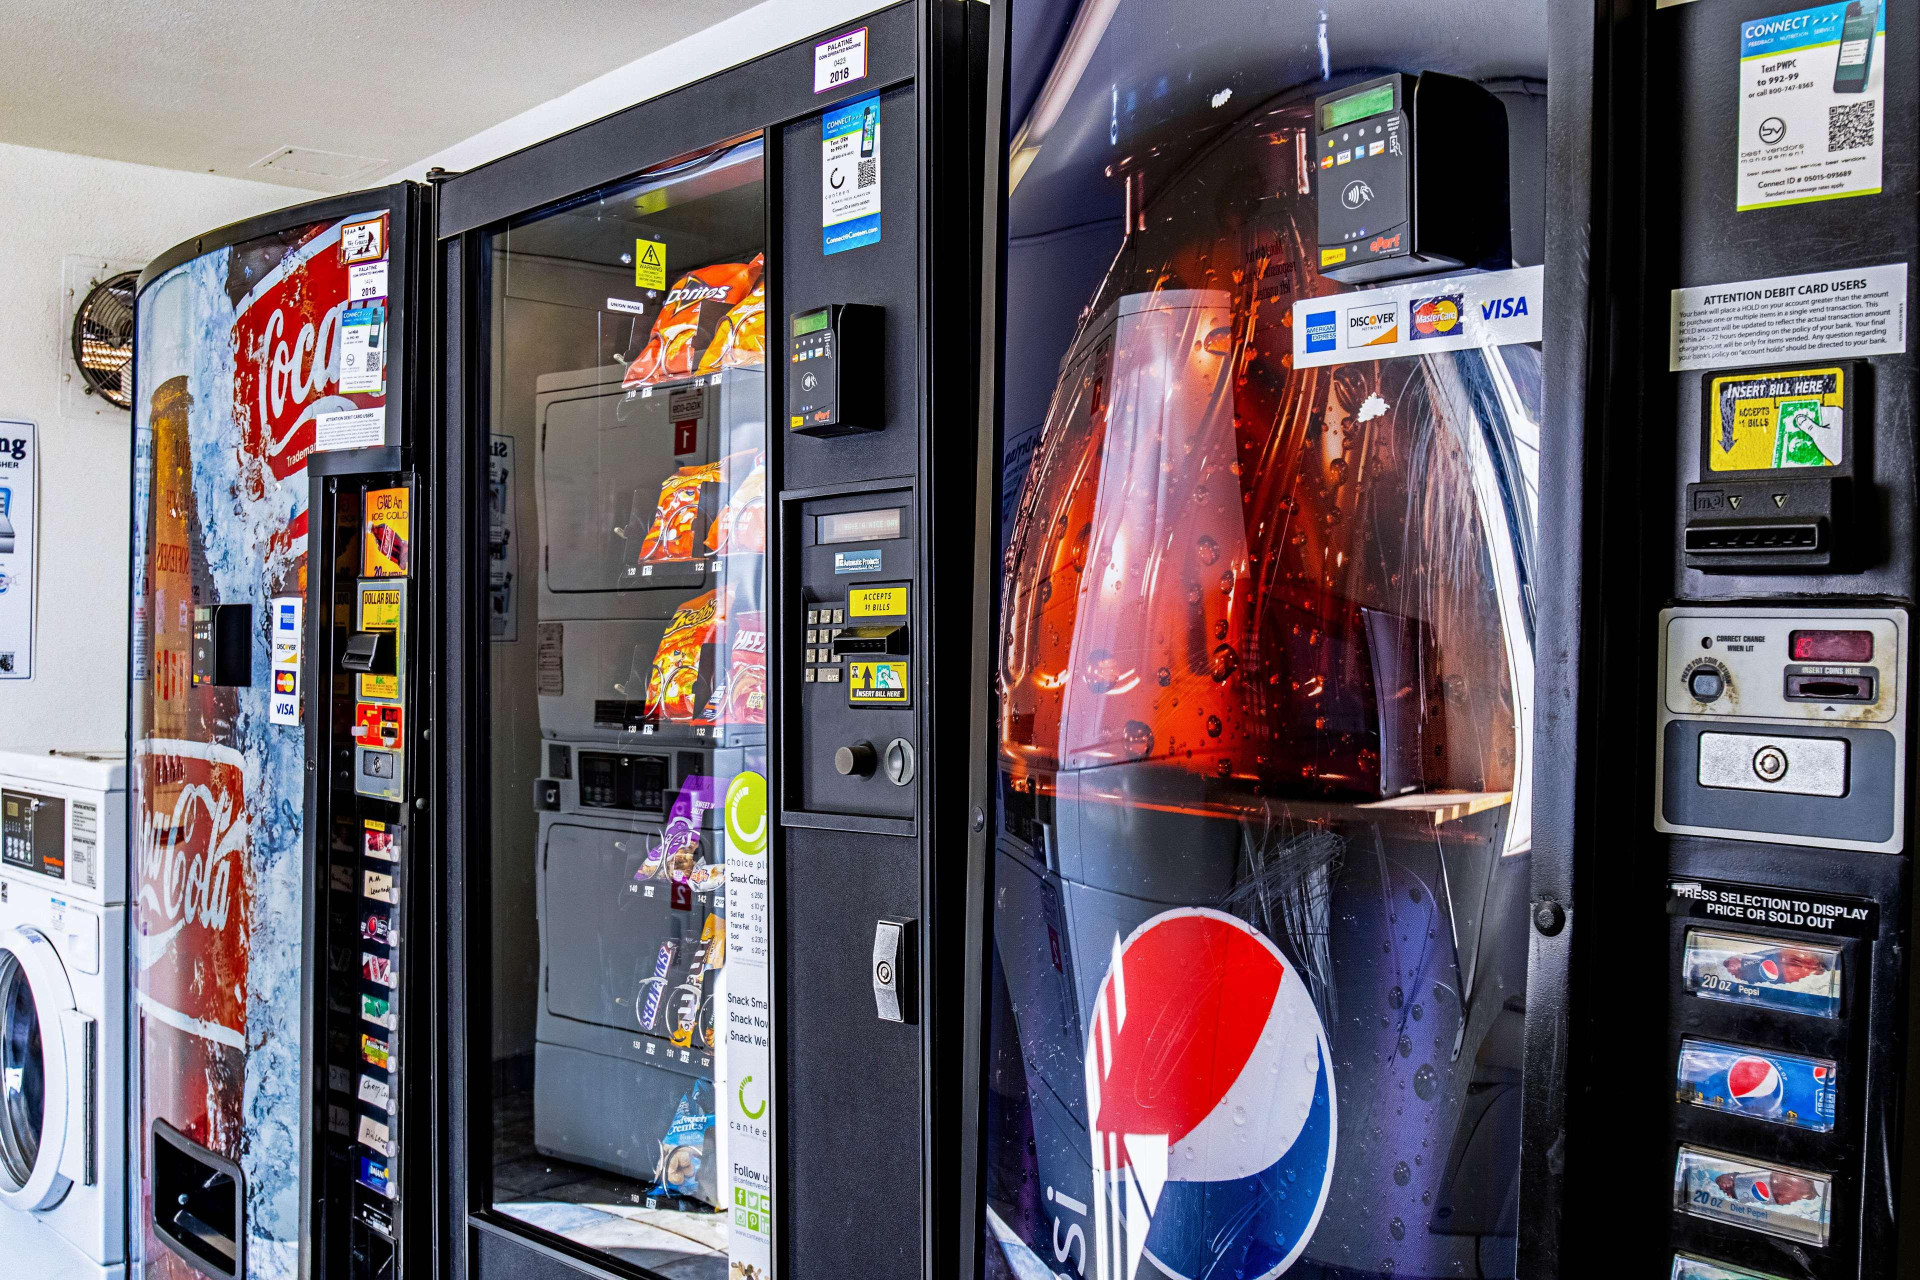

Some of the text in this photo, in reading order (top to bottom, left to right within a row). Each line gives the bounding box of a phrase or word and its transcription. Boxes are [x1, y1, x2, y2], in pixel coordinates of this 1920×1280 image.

[1745, 15, 1811, 39] CONNECT
[827, 37, 853, 52] PALATINE
[1761, 59, 1797, 74] Text PWPC
[829, 67, 849, 84] 2018
[1757, 73, 1799, 87] to 992-99
[1756, 89, 1767, 98] call
[826, 115, 852, 130] CONNECT
[1765, 143, 1805, 154] vendors
[1758, 177, 1795, 189] Connect ID
[361, 286, 377, 297] 2018
[665, 285, 731, 306] Doritos
[1704, 279, 1867, 306] ATTENTION DEBIT CARD USERS
[1481, 296, 1529, 321] VISA
[1693, 309, 1708, 317] bank
[1720, 307, 1736, 315] place
[1770, 302, 1784, 310] your
[1811, 298, 1834, 306] greater
[1863, 291, 1889, 299] amount
[1350, 311, 1395, 328] DISCOVER
[1415, 311, 1457, 325] MasterCard
[1306, 324, 1335, 335] AMERICAN
[1311, 332, 1337, 341] EXPRESS
[1727, 379, 1824, 399] INSERT BILL HERE
[1747, 418, 1769, 429] BILLS
[365, 591, 400, 605] DOLLAR BILLS
[863, 592, 892, 601] ACCEPTS
[872, 603, 890, 611] BILLS
[1716, 635, 1766, 643] CORRECT CHANGE
[1727, 644, 1754, 653] WHEN LIT
[1681, 662, 1694, 684] PRESS
[1692, 657, 1704, 669] FOR
[1704, 656, 1719, 668] COIN
[1802, 667, 1861, 675] INSERT COINS HERE
[856, 688, 901, 698] INSERT BILL HERE
[276, 703, 294, 716] VISA
[726, 858, 754, 869] choice
[730, 872, 748, 884] Snack
[730, 888, 738, 896] Cal
[1676, 886, 1869, 921] PRESS SELECTION TO DISPLAY
[1706, 903, 1835, 930] PRICE OR SOLD OUT
[1701, 974, 1760, 997] 20 Pepsi
[727, 992, 750, 1007] Snack
[730, 1011, 752, 1027] Snack
[730, 1030, 752, 1045] Snack
[734, 1162, 761, 1182] Follow
[1692, 1190, 1769, 1221] 20 Diet Pepsi
